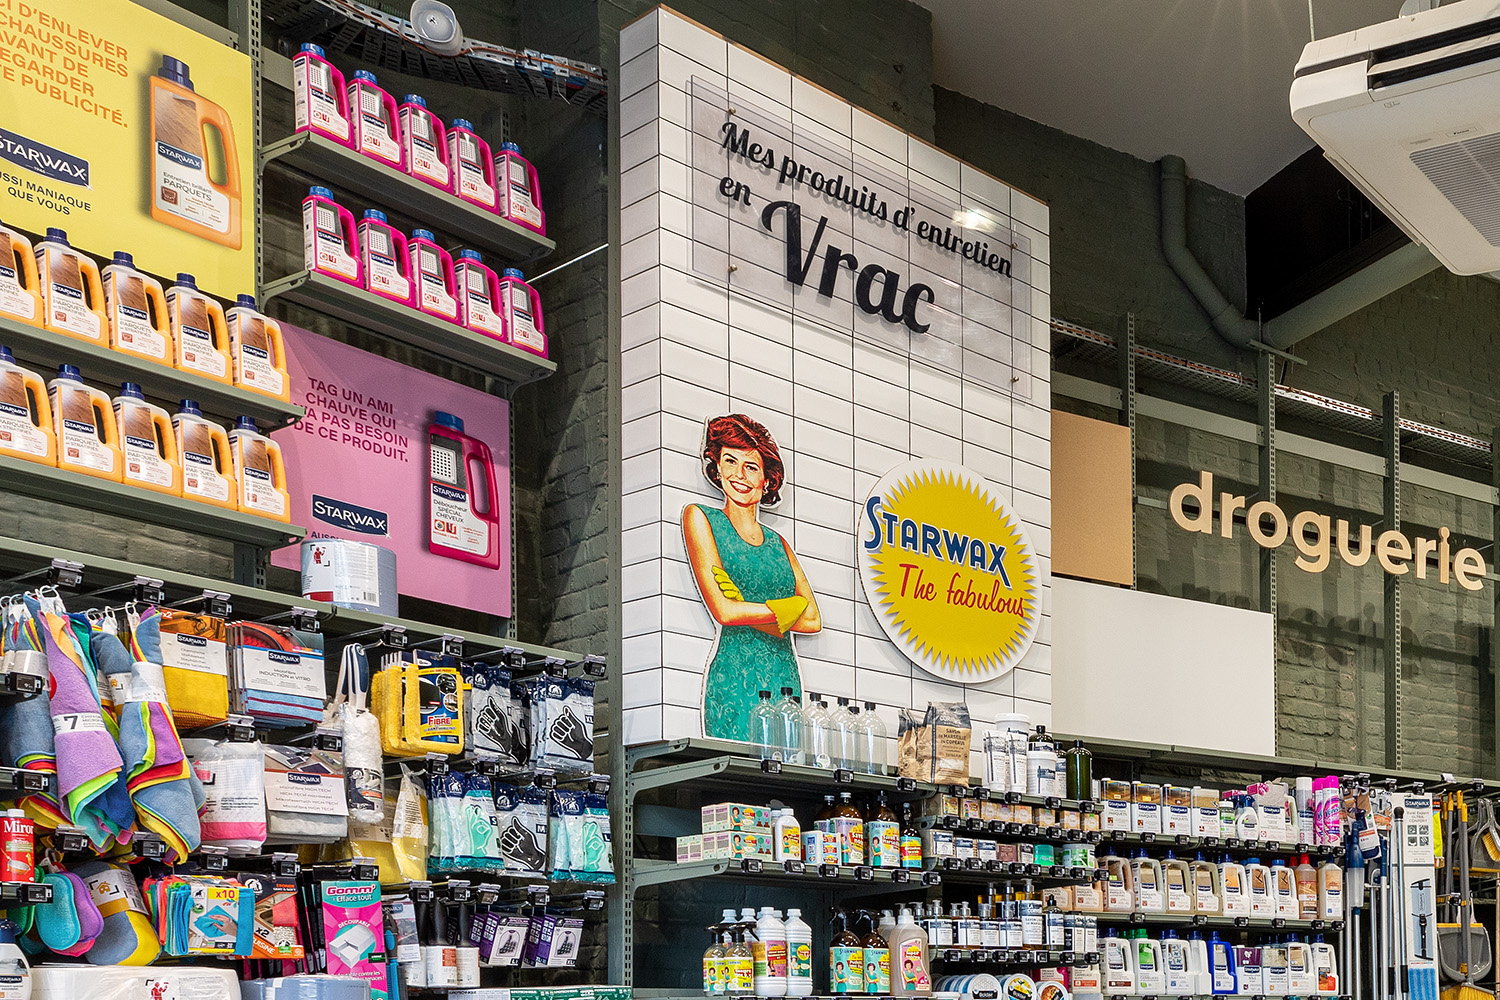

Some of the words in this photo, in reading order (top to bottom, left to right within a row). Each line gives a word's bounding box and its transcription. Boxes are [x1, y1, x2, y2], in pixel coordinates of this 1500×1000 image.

[19, 2, 129, 62] D'ENLEVER
[0, 46, 94, 97] EGARDER
[63, 56, 88, 78] DE
[0, 64, 15, 82] E
[21, 73, 128, 128] PUBLICITÉ.
[159, 145, 201, 168] STARWAX
[7, 187, 34, 203] QUE
[36, 196, 70, 215] VOUS
[26, 181, 92, 212] MANIAQUE
[163, 178, 212, 201] PARQUETS
[719, 176, 752, 207] en
[720, 121, 776, 170] Mes
[778, 153, 888, 221] produits
[916, 219, 1013, 279] entretien
[761, 200, 936, 335] Vrac
[308, 377, 338, 396] TAG
[342, 388, 363, 405] UN
[367, 397, 393, 414] AMI
[306, 392, 368, 421] CHAUVE
[371, 412, 396, 430] QUI
[318, 426, 338, 442] CE
[342, 433, 408, 463] PRODUIT.
[322, 412, 350, 430] PAS
[355, 422, 408, 448] BESOIN
[433, 485, 466, 500] STARWAX
[314, 501, 387, 531] STARWAX
[1168, 470, 1487, 591] droguerie
[864, 496, 1012, 589] STARWAX
[899, 562, 938, 602] The
[945, 571, 1026, 619] fabulous
[178, 635, 206, 646] STARWAX
[268, 652, 300, 663] STARWAX
[427, 716, 451, 725] FIBRE
[289, 774, 321, 784] STARWAX
[4, 820, 34, 834] Miror
[216, 889, 235, 899] x10
[336, 895, 357, 903] Efface
[255, 927, 270, 938] x2
